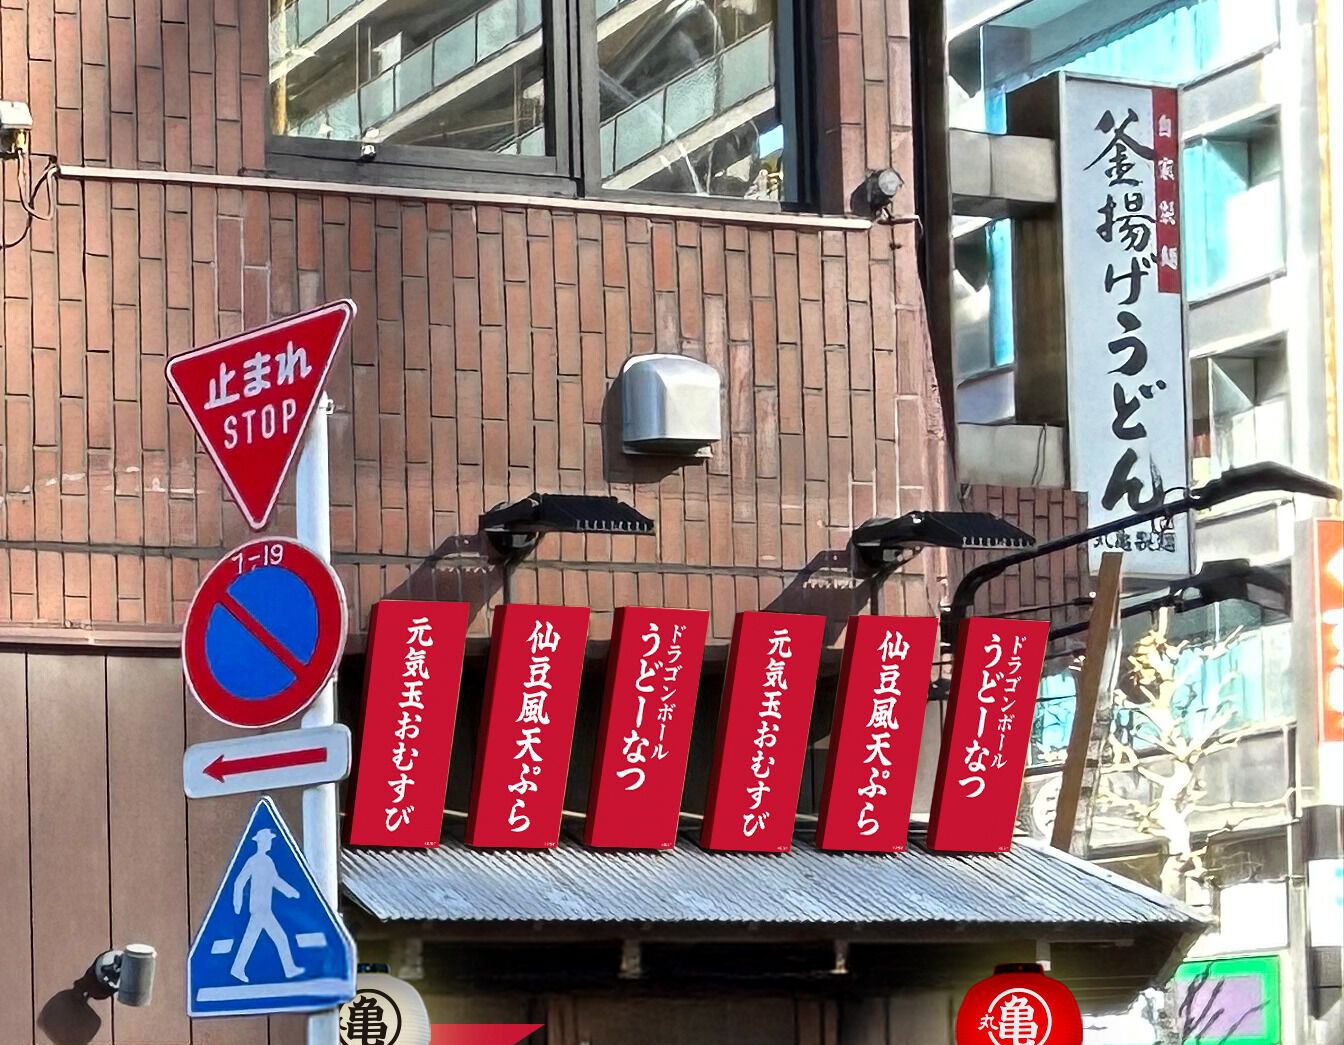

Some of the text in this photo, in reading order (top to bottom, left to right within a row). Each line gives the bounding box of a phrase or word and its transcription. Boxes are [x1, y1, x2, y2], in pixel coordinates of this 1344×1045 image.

[204, 340, 312, 410] 止まれ
[1083, 107, 1167, 512] 釜揚げうどん
[224, 398, 296, 449] STOP
[232, 543, 284, 574] 7-19
[385, 616, 434, 832] 元気玉おむすび
[507, 619, 561, 832] 仙豆風天ぷら
[615, 622, 664, 791] うどーなつ
[650, 623, 687, 760] ドラゴンボール
[742, 629, 792, 837] 元気玉おむすび
[857, 630, 910, 836] 仙豆風天ぷら
[958, 633, 1004, 798] うどーなつ
[990, 635, 1028, 769] ドラゴンボール
